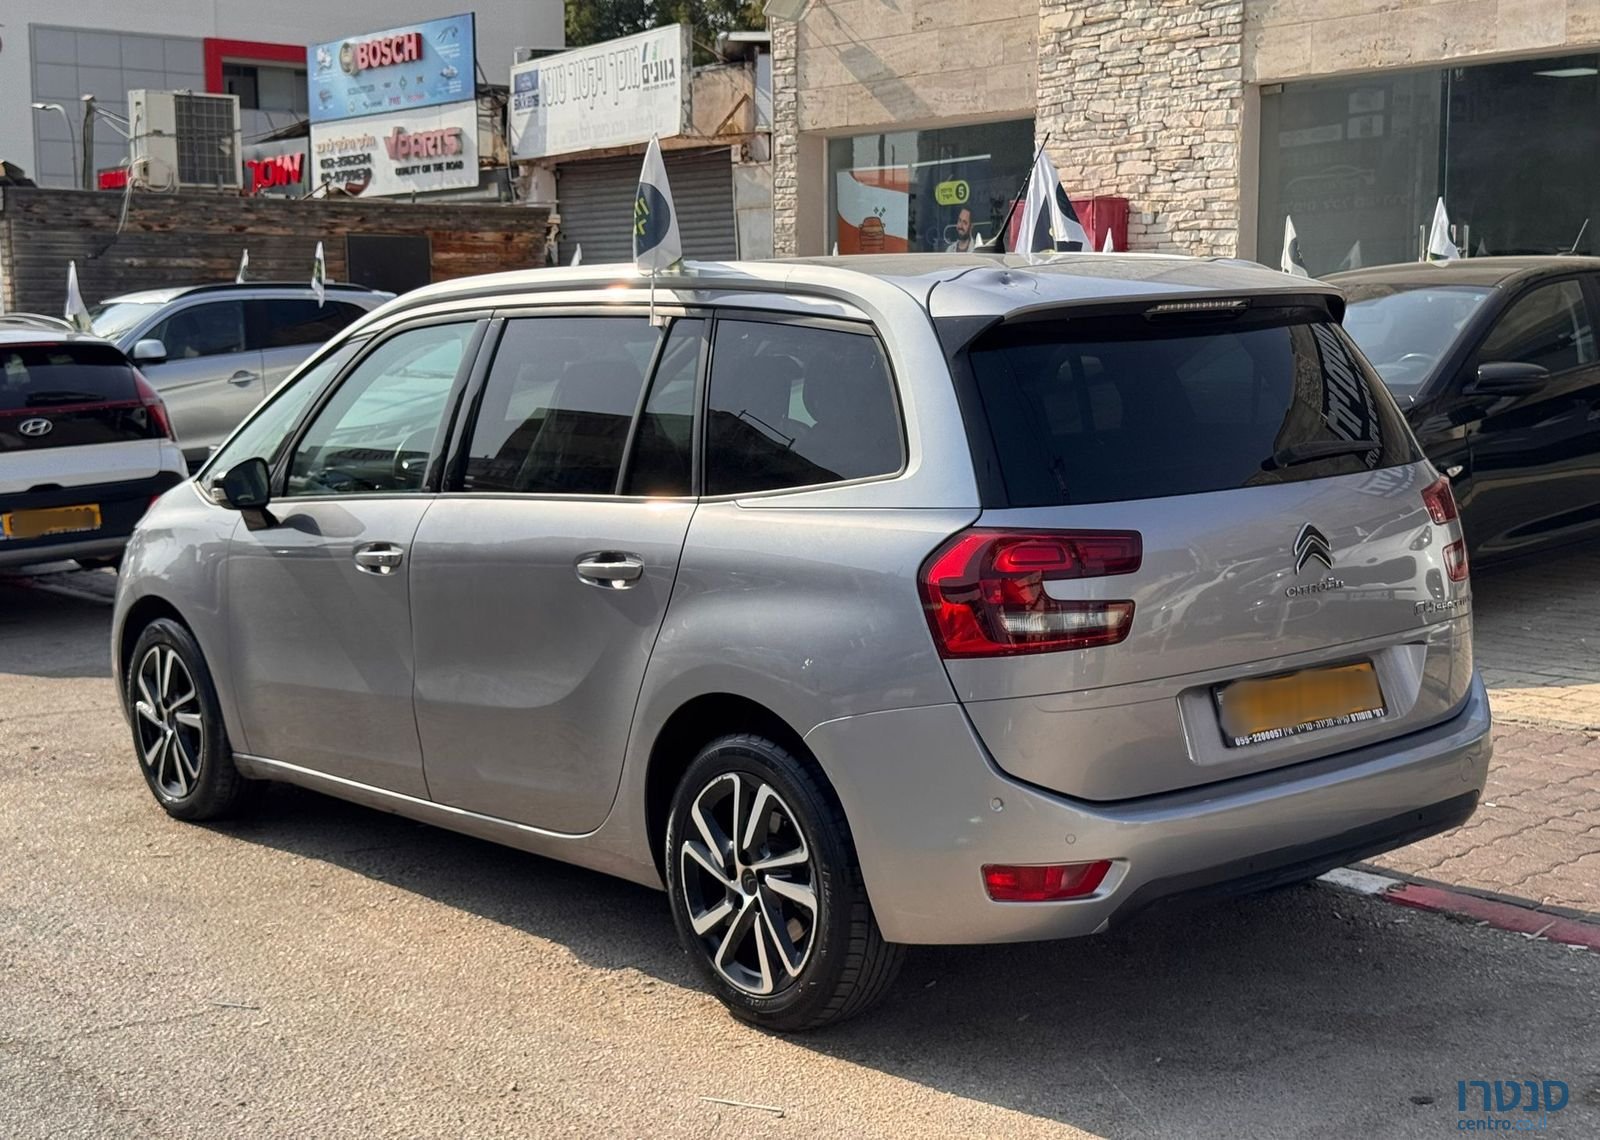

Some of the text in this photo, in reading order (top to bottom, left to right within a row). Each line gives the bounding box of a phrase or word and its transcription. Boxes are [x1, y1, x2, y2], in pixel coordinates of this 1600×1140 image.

[356, 32, 422, 70] BOSCH
[642, 57, 676, 85] גוונים
[395, 165, 420, 176] QUALITY
[432, 162, 444, 172] THE
[445, 160, 464, 171] ROAD
